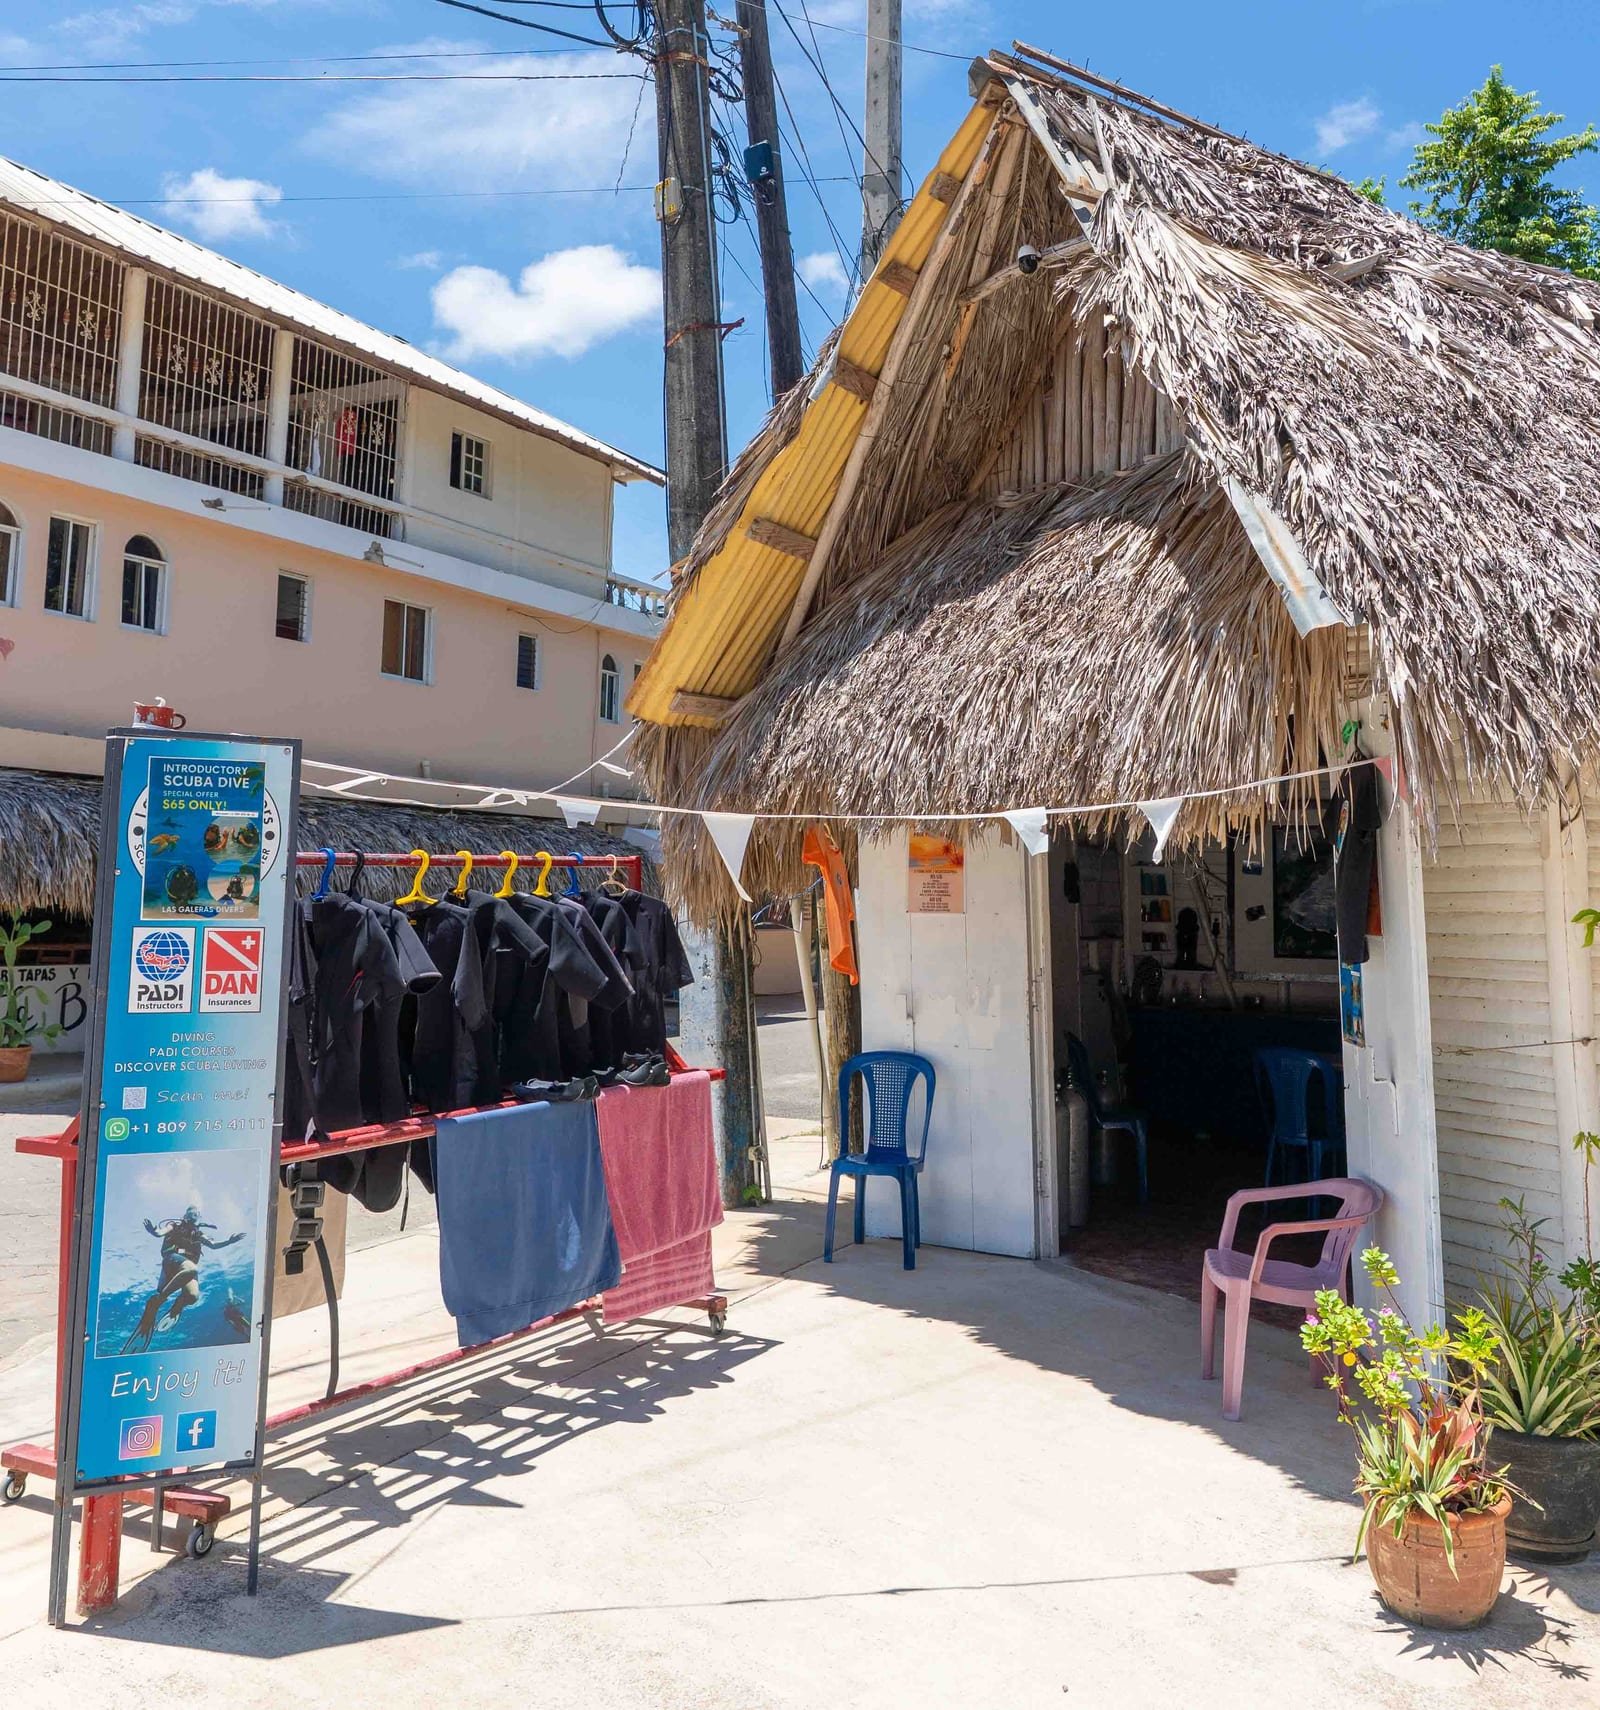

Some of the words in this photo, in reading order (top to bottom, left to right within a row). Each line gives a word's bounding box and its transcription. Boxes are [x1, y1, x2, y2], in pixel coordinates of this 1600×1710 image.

[163, 764, 248, 775] INTRODUCTORY
[163, 775, 213, 788] SCUBA
[218, 777, 250, 789] DIVE
[163, 790, 193, 798] SPECIAL
[188, 799, 227, 811] ONLY!
[162, 905, 177, 913] LAS
[179, 905, 214, 913] GALERAS
[215, 905, 245, 914] DIVERS
[18, 967, 56, 982] TAPAS
[69, 967, 79, 980] Y
[204, 973, 258, 995] DAN
[137, 984, 184, 1002] PADI
[136, 1002, 183, 1010] Instructors
[172, 1032, 216, 1042] DIVING
[149, 1047, 178, 1057] PADI
[181, 1046, 236, 1057] COURSES
[114, 1062, 176, 1073] DISCOVER
[180, 1061, 220, 1071] SCUBA
[223, 1059, 267, 1070] DIVING
[157, 1089, 203, 1103] Scan
[131, 1123, 149, 1134] +1
[157, 1121, 187, 1133] 809
[193, 1120, 222, 1132] 715
[227, 1118, 266, 1130] 4111
[110, 1366, 199, 1402] Enjoy
[212, 1359, 246, 1387] it!
